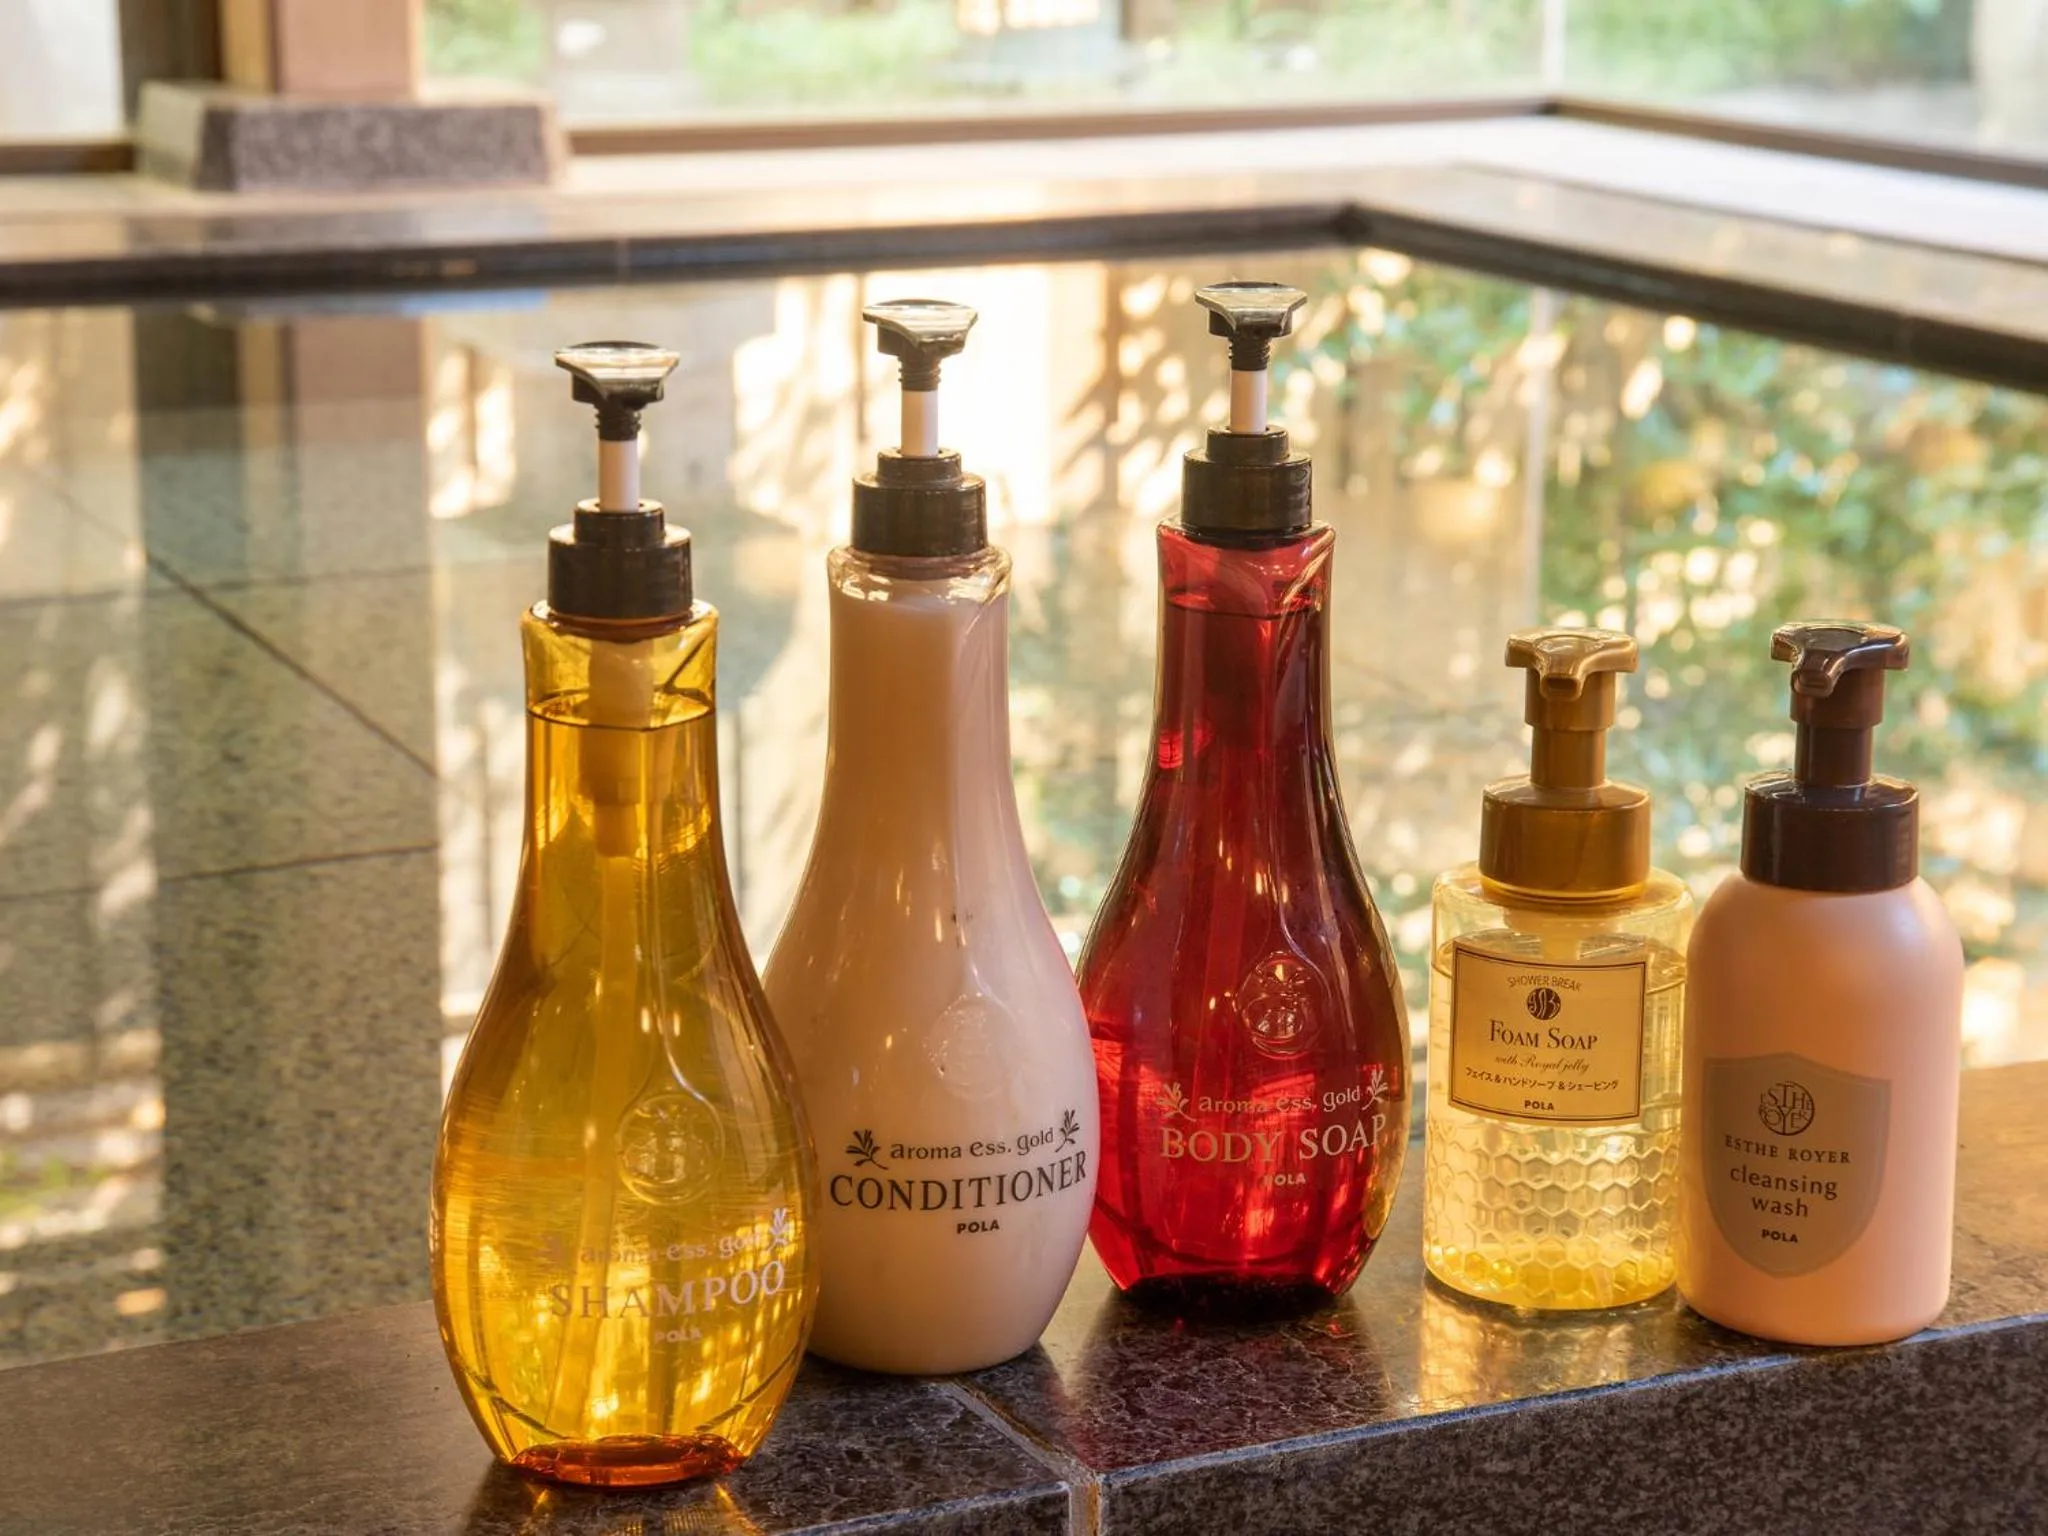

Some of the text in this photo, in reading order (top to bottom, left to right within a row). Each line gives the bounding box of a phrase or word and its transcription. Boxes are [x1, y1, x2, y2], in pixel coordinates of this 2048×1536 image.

[1508, 975, 1582, 992] SHOWER BREAK
[1495, 1054, 1590, 1074] with Royal jelly
[1200, 1086, 1361, 1114] aroma ess. gold
[1525, 1100, 1554, 1111] POLA
[890, 1127, 1055, 1160] aroma ess. gold
[1161, 1113, 1386, 1162] BODY SOAP
[1725, 1135, 1850, 1164] ESTHE ROYER
[830, 1150, 1087, 1211] CONDITIONER
[1730, 1165, 1838, 1200] cleansing
[1752, 1198, 1809, 1217] wash
[957, 1219, 1000, 1234] POLA
[1761, 1229, 1798, 1243] POLA
[550, 1260, 785, 1320] SHAMPOO
